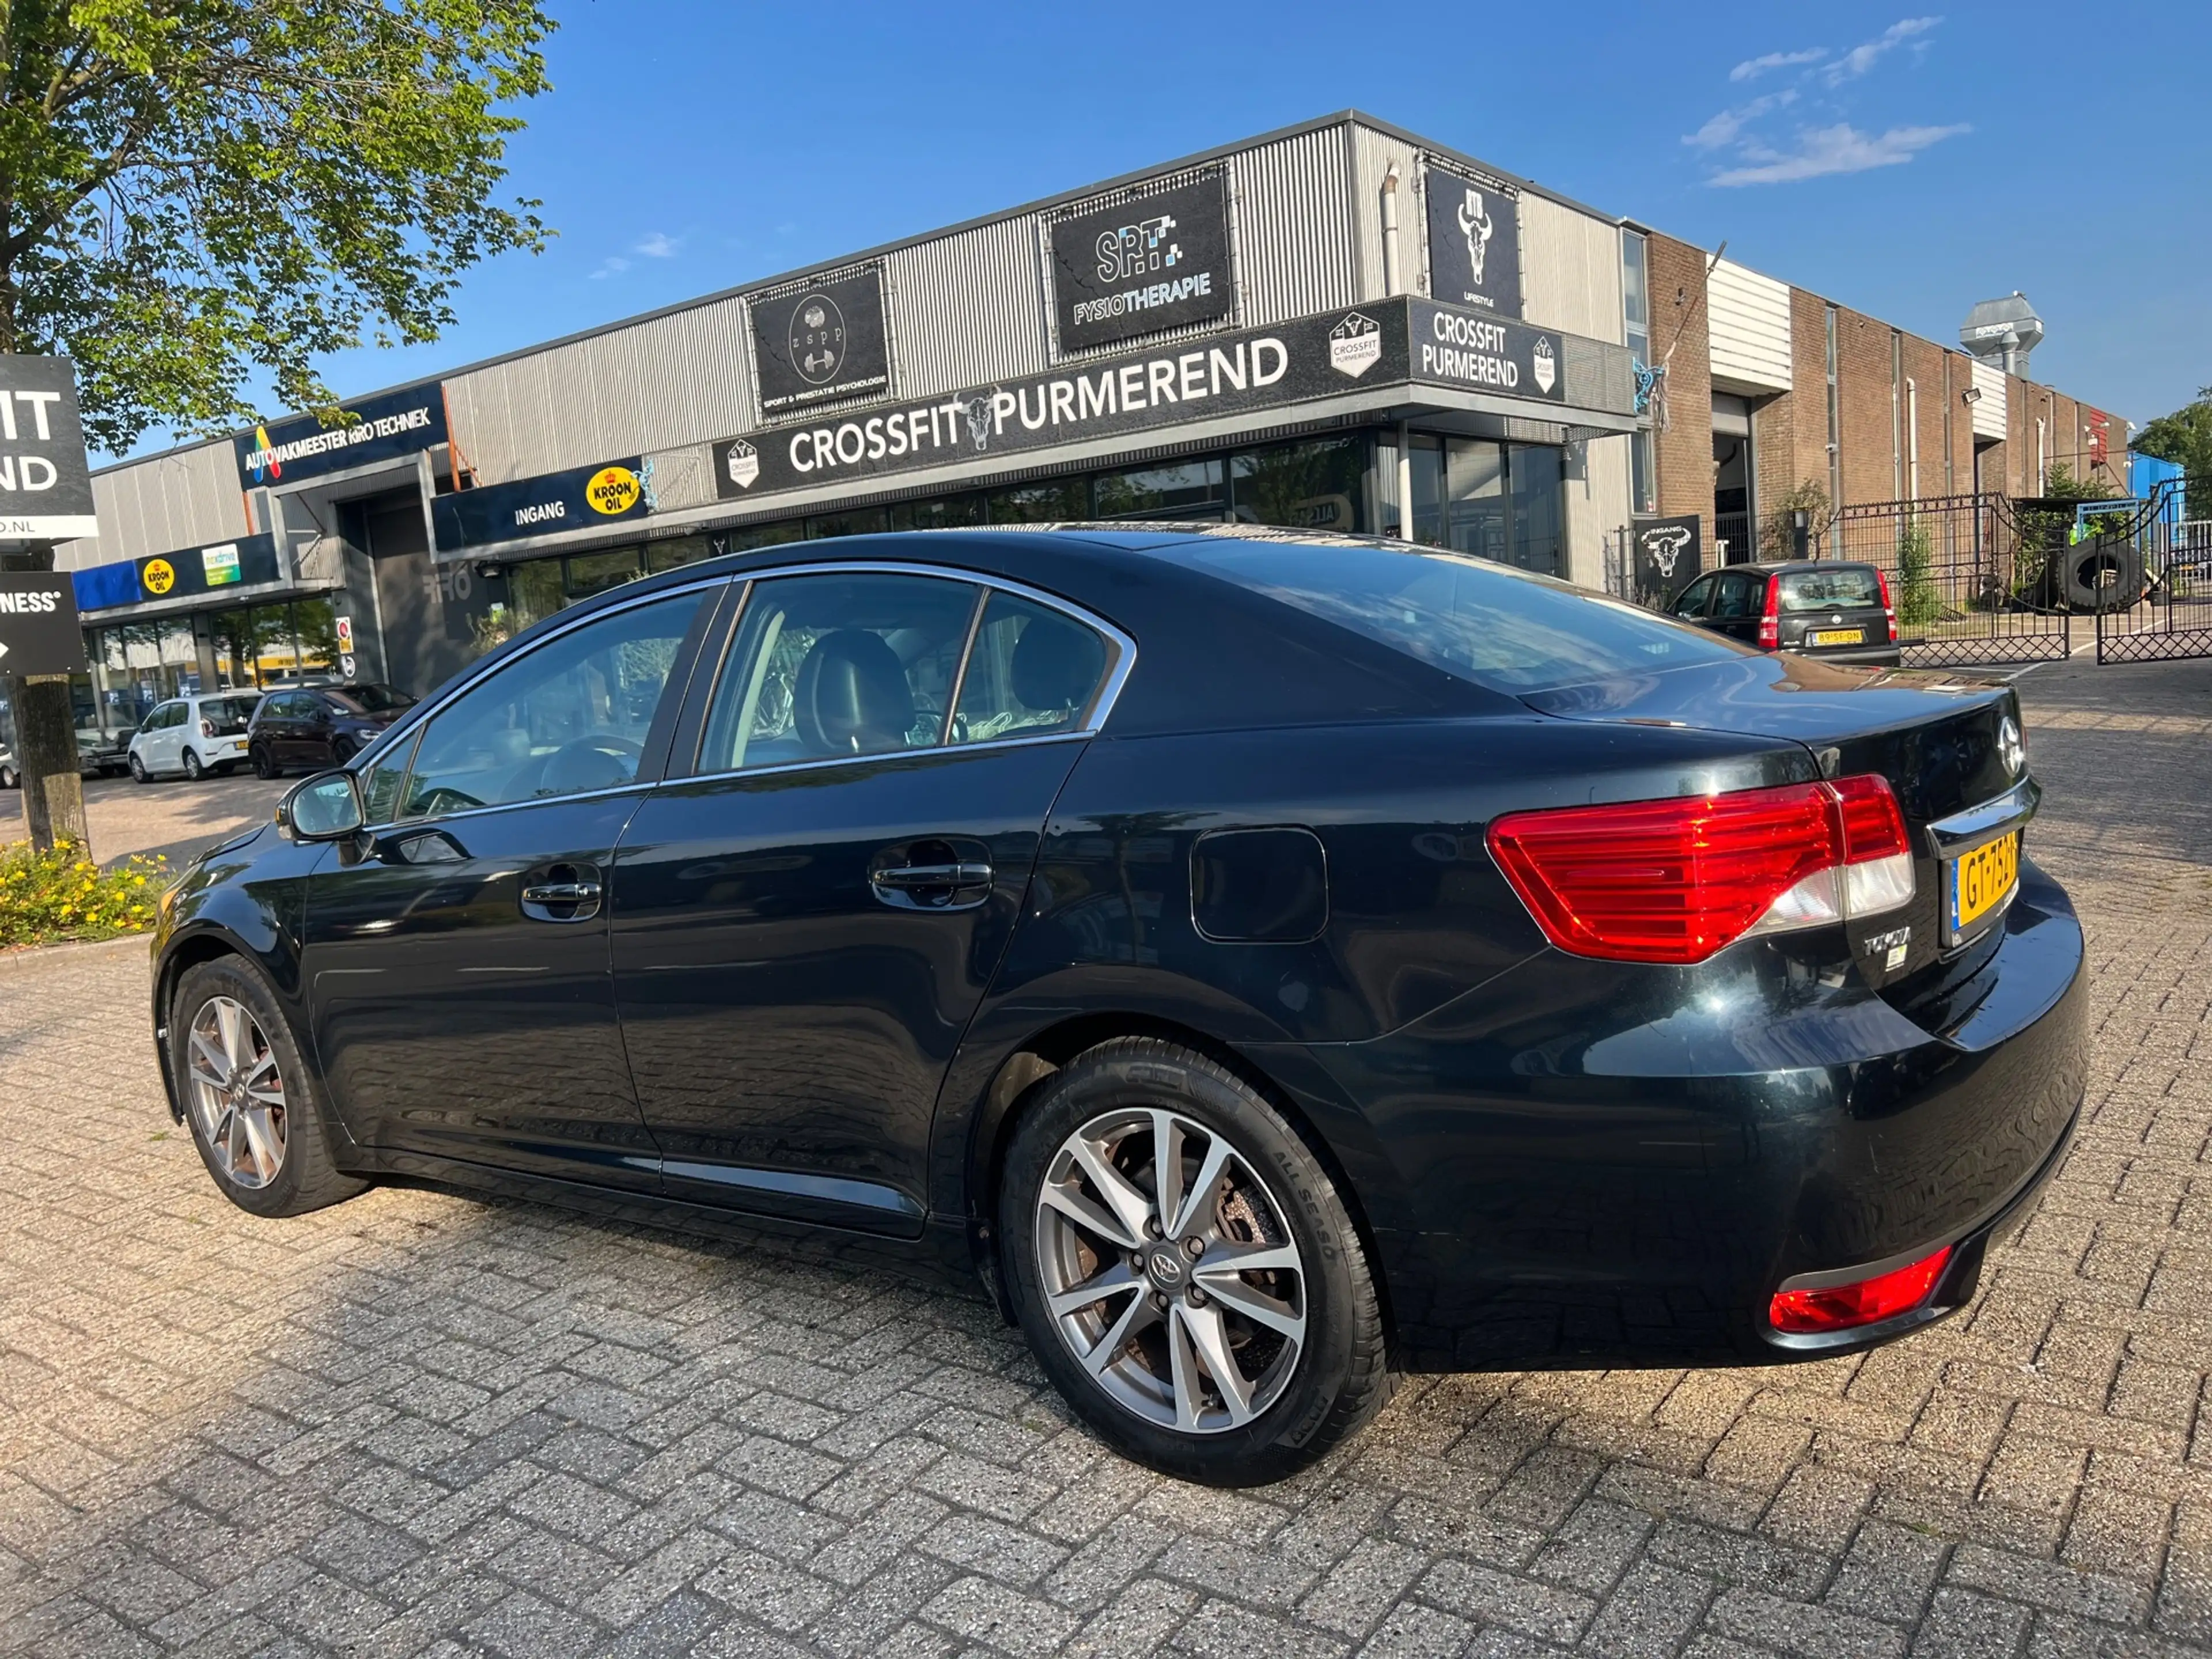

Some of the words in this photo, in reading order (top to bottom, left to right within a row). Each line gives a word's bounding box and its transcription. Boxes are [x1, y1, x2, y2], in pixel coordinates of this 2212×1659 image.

[1096, 215, 1171, 282] SRT
[1074, 272, 1211, 324] FYSIOTHERAPIE
[1334, 340, 1377, 355] CROSSFIT
[1434, 312, 1505, 353] CROSSFIT
[1423, 344, 1518, 387] PURMEREND
[764, 396, 787, 407] SPORT
[796, 387, 835, 401] PRESTATIE
[836, 375, 887, 392] PSYCHOLOGIE
[789, 402, 963, 472] CROSSFIT
[993, 338, 1289, 435] PURMEREND
[246, 430, 347, 471] AUTOVAKMEESTER
[373, 407, 431, 438] TECHNIEK
[594, 482, 631, 500] KROON
[605, 498, 622, 511] OIL
[515, 501, 565, 525] INGANG
[1650, 525, 1681, 535] INGANG
